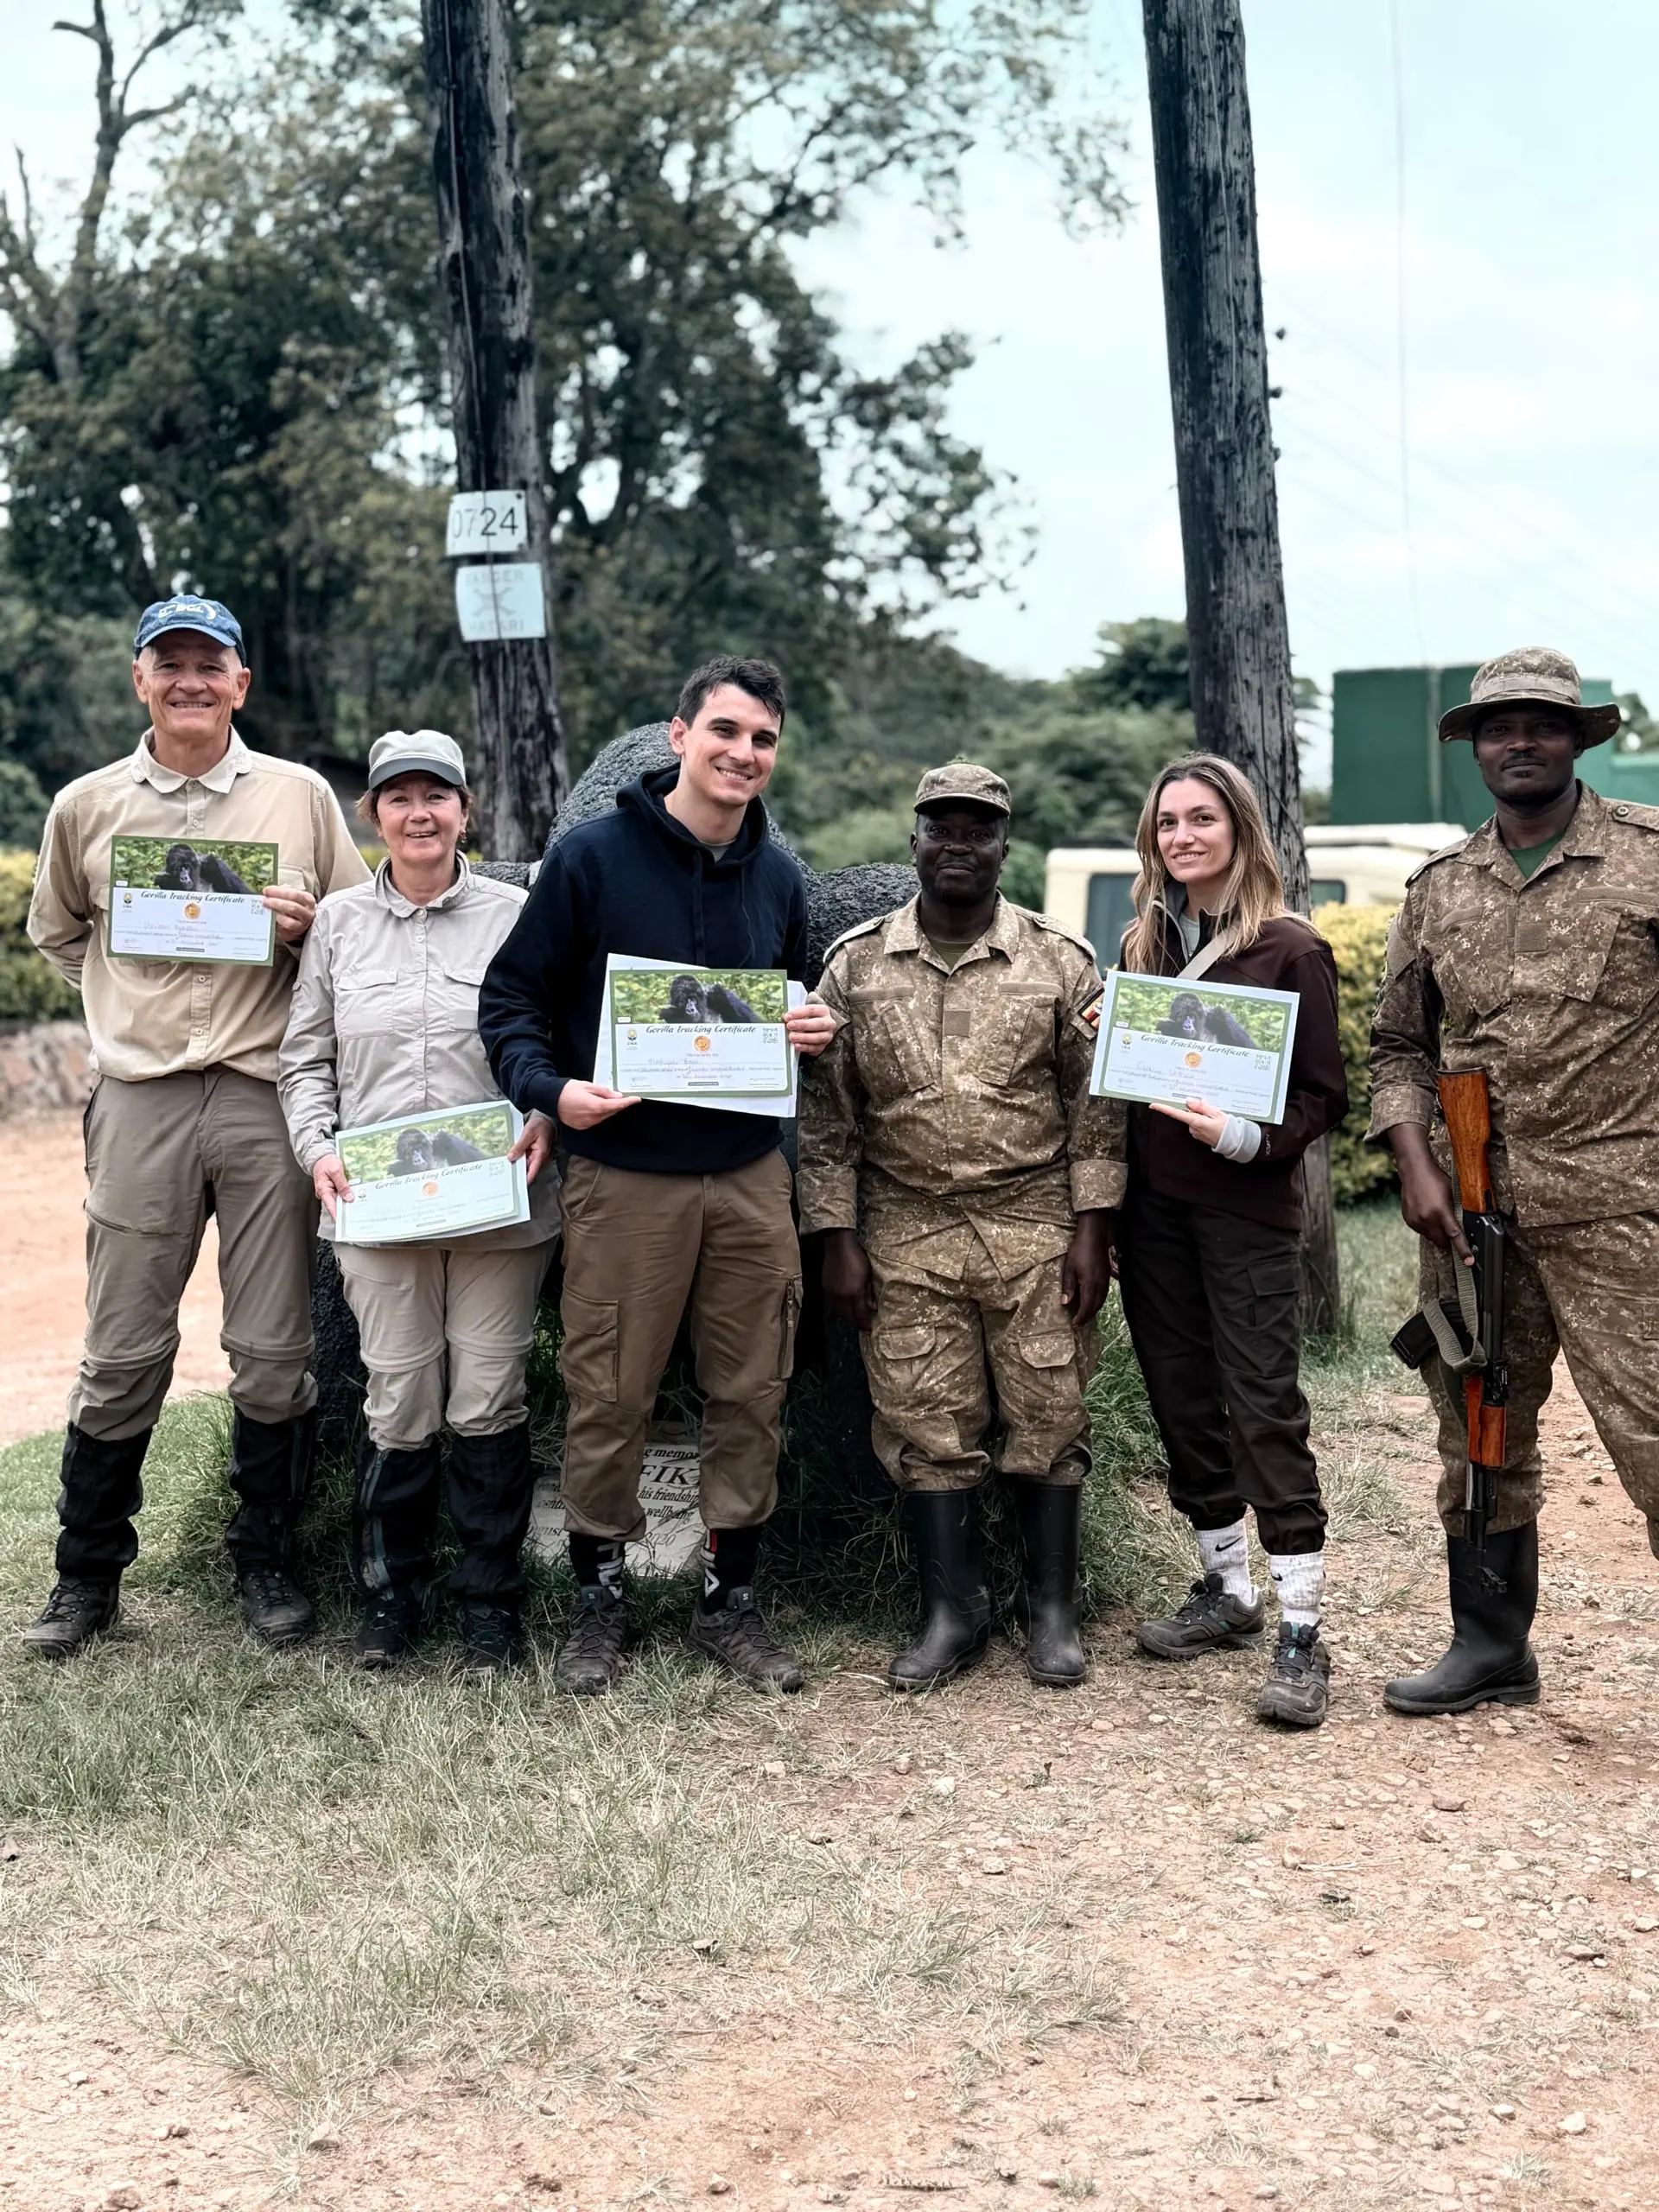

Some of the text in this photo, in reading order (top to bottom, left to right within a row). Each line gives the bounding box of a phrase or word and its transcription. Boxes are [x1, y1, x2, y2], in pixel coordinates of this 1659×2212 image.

[453, 506, 518, 538] 0724
[140, 891, 245, 905] Gorilla Tracking Certificate
[677, 1026, 712, 1035] Tracking
[714, 1026, 757, 1035] Certificate
[1141, 1034, 1251, 1058] Gorilla Tracking Certificate
[375, 1179, 402, 1190] Gorilla
[405, 1172, 439, 1185] Tracking
[442, 1164, 483, 1178] Certificate
[653, 1449, 700, 1463] memo
[639, 1465, 700, 1485] FIK
[652, 1487, 699, 1508] friendship
[646, 1505, 694, 1525] wellbing
